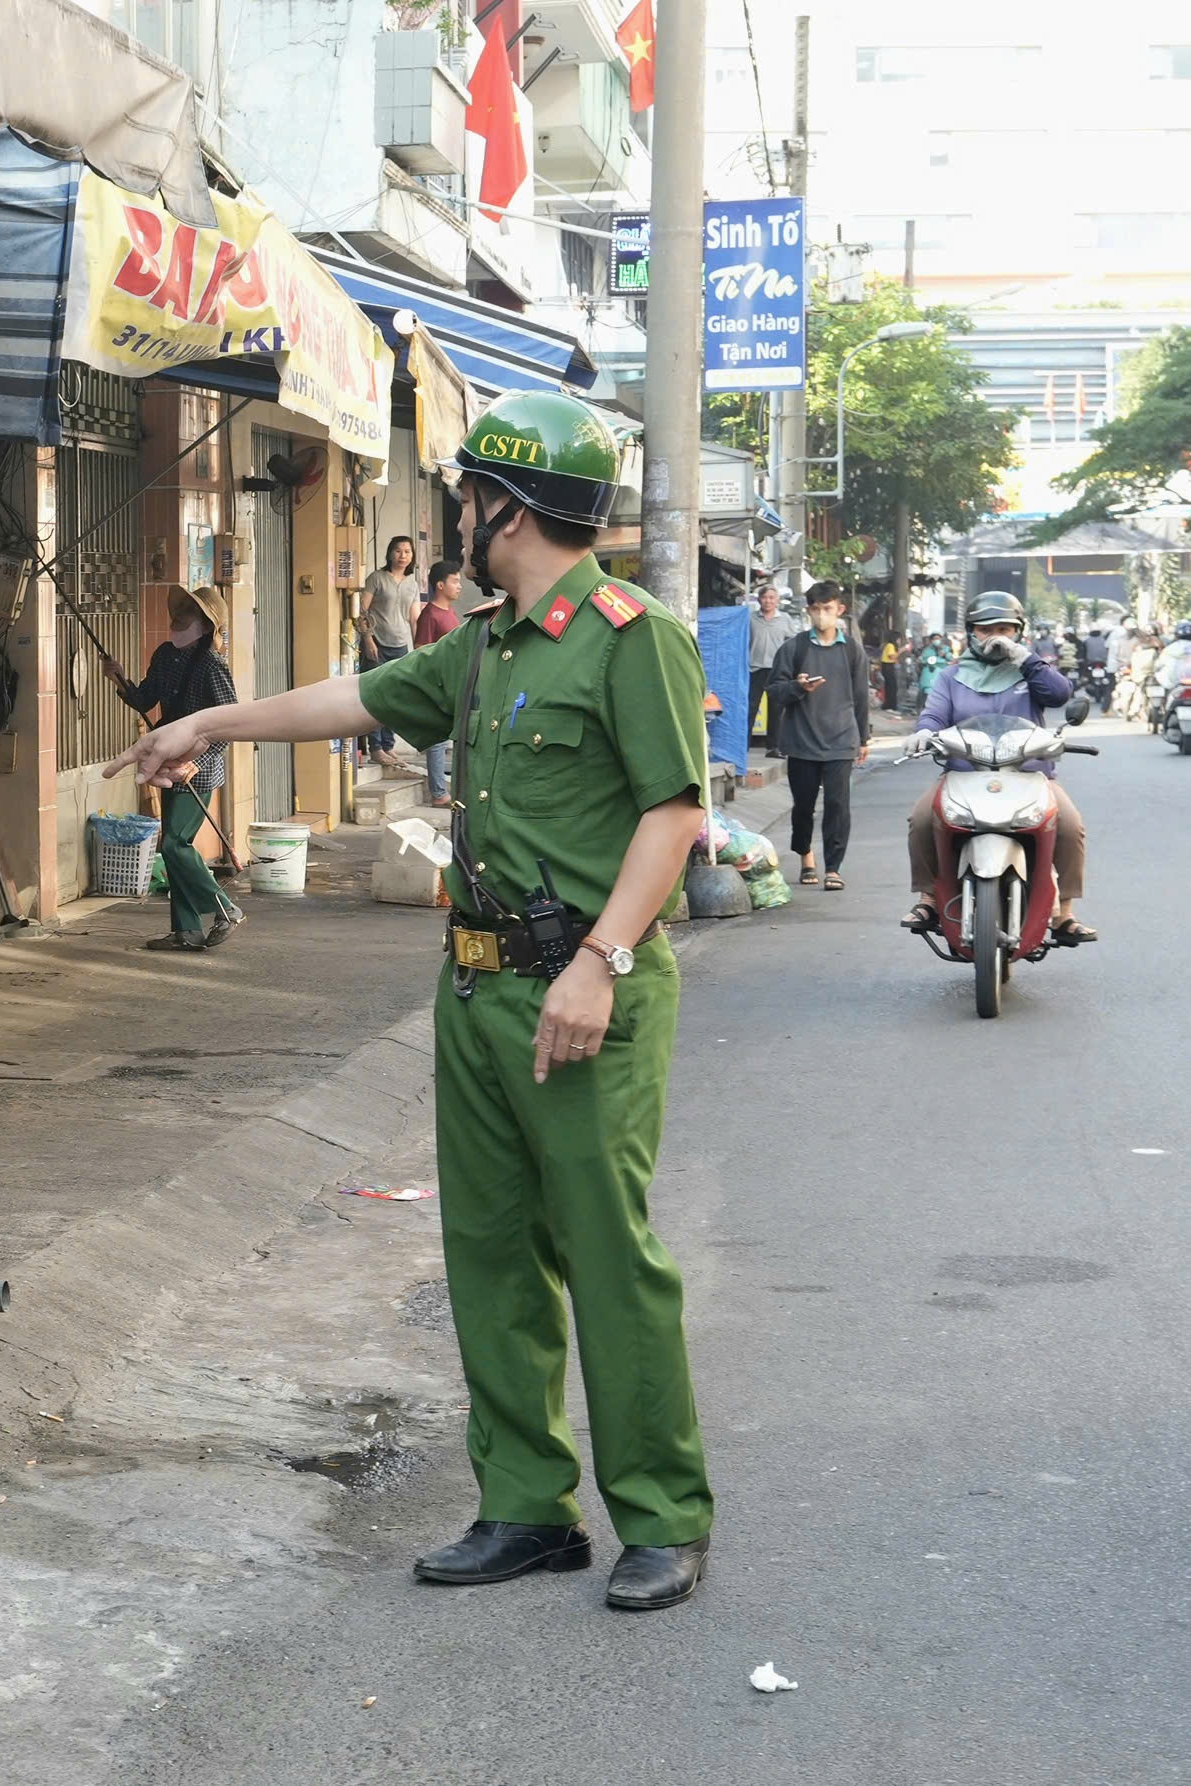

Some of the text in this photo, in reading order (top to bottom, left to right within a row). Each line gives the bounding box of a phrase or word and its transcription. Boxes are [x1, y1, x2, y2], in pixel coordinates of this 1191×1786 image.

[706, 209, 801, 249] Sinh Tố
[707, 313, 800, 335] Giao Hàng
[112, 325, 176, 362] 31/14
[719, 342, 787, 366] Tận Nơi
[479, 433, 545, 464] CSTT
